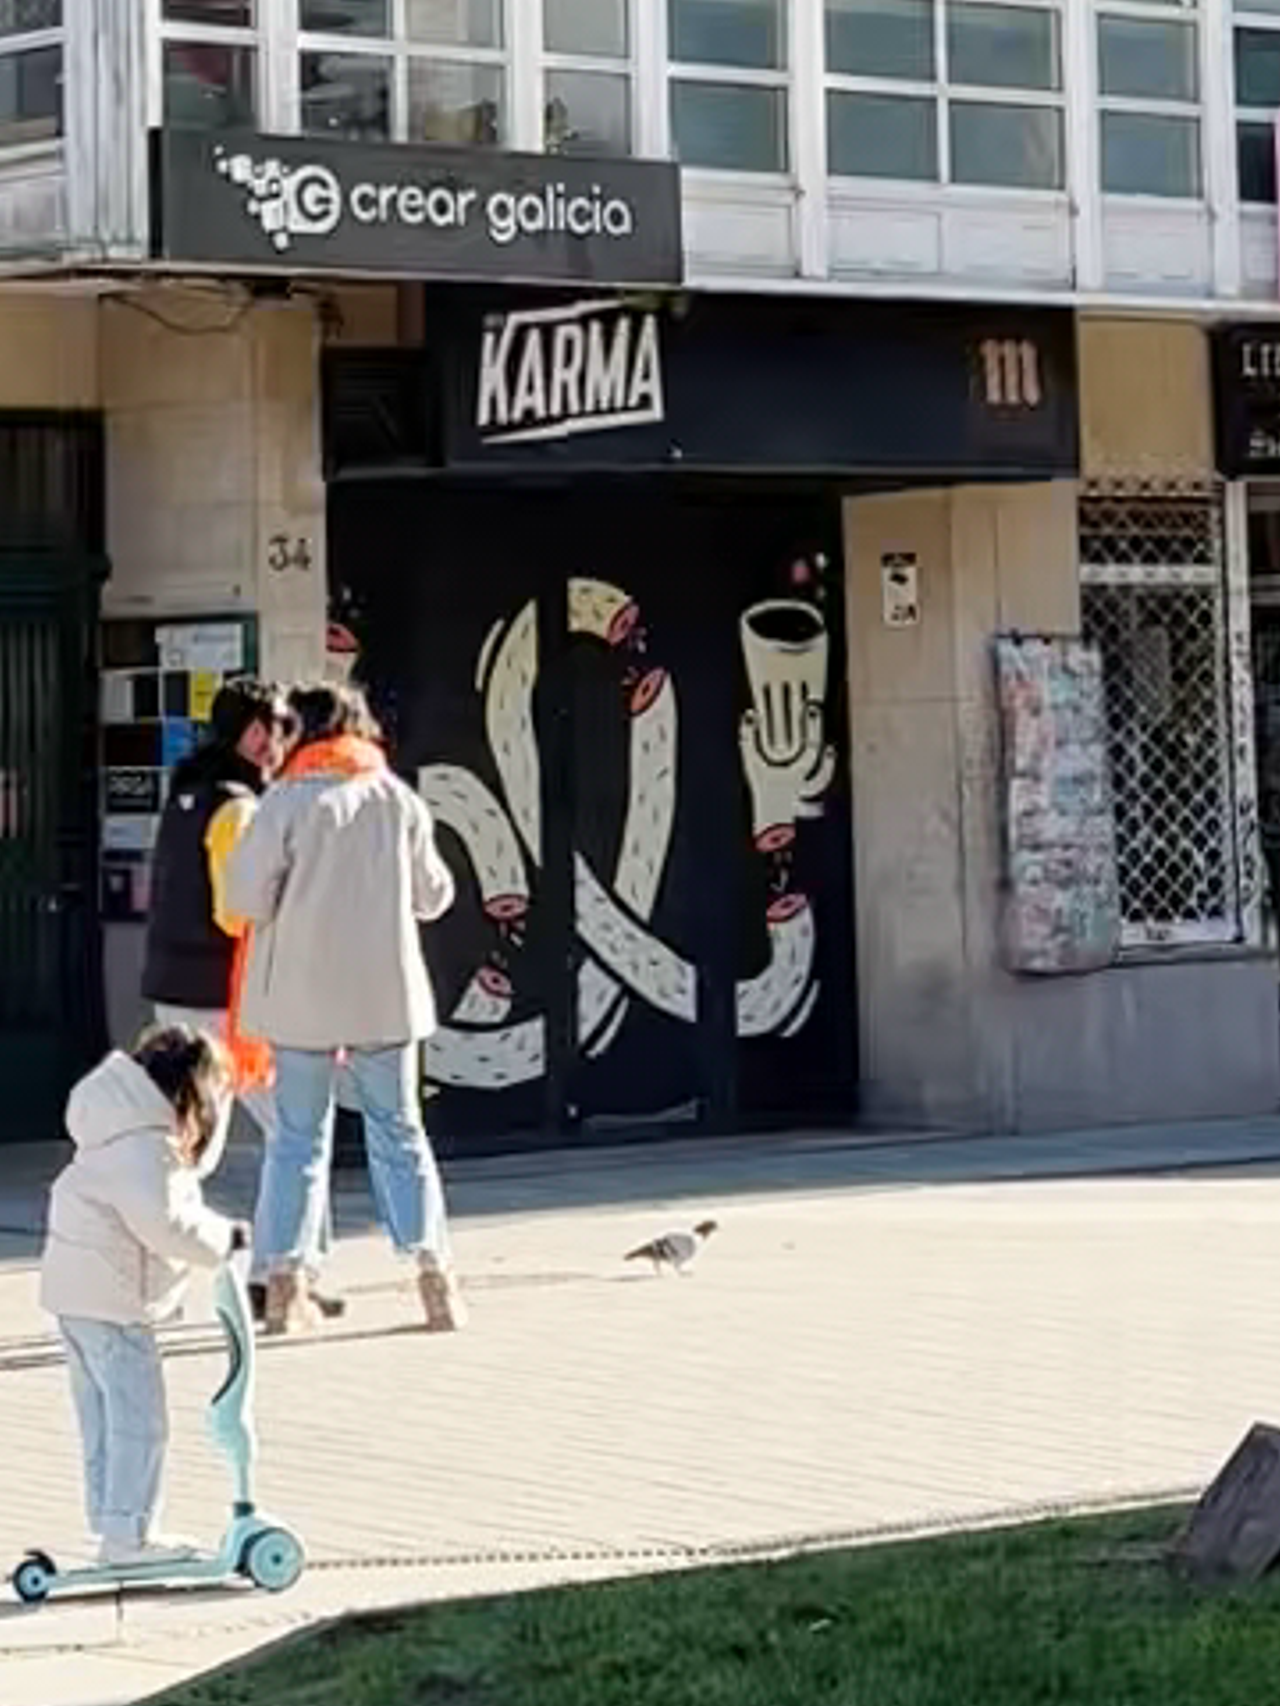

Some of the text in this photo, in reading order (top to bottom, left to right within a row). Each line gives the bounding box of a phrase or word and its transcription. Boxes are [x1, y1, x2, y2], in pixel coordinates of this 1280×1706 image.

[349, 182, 477, 227] crear
[485, 181, 634, 244] galicia
[477, 306, 665, 431] KARMA
[268, 536, 312, 572] 34
